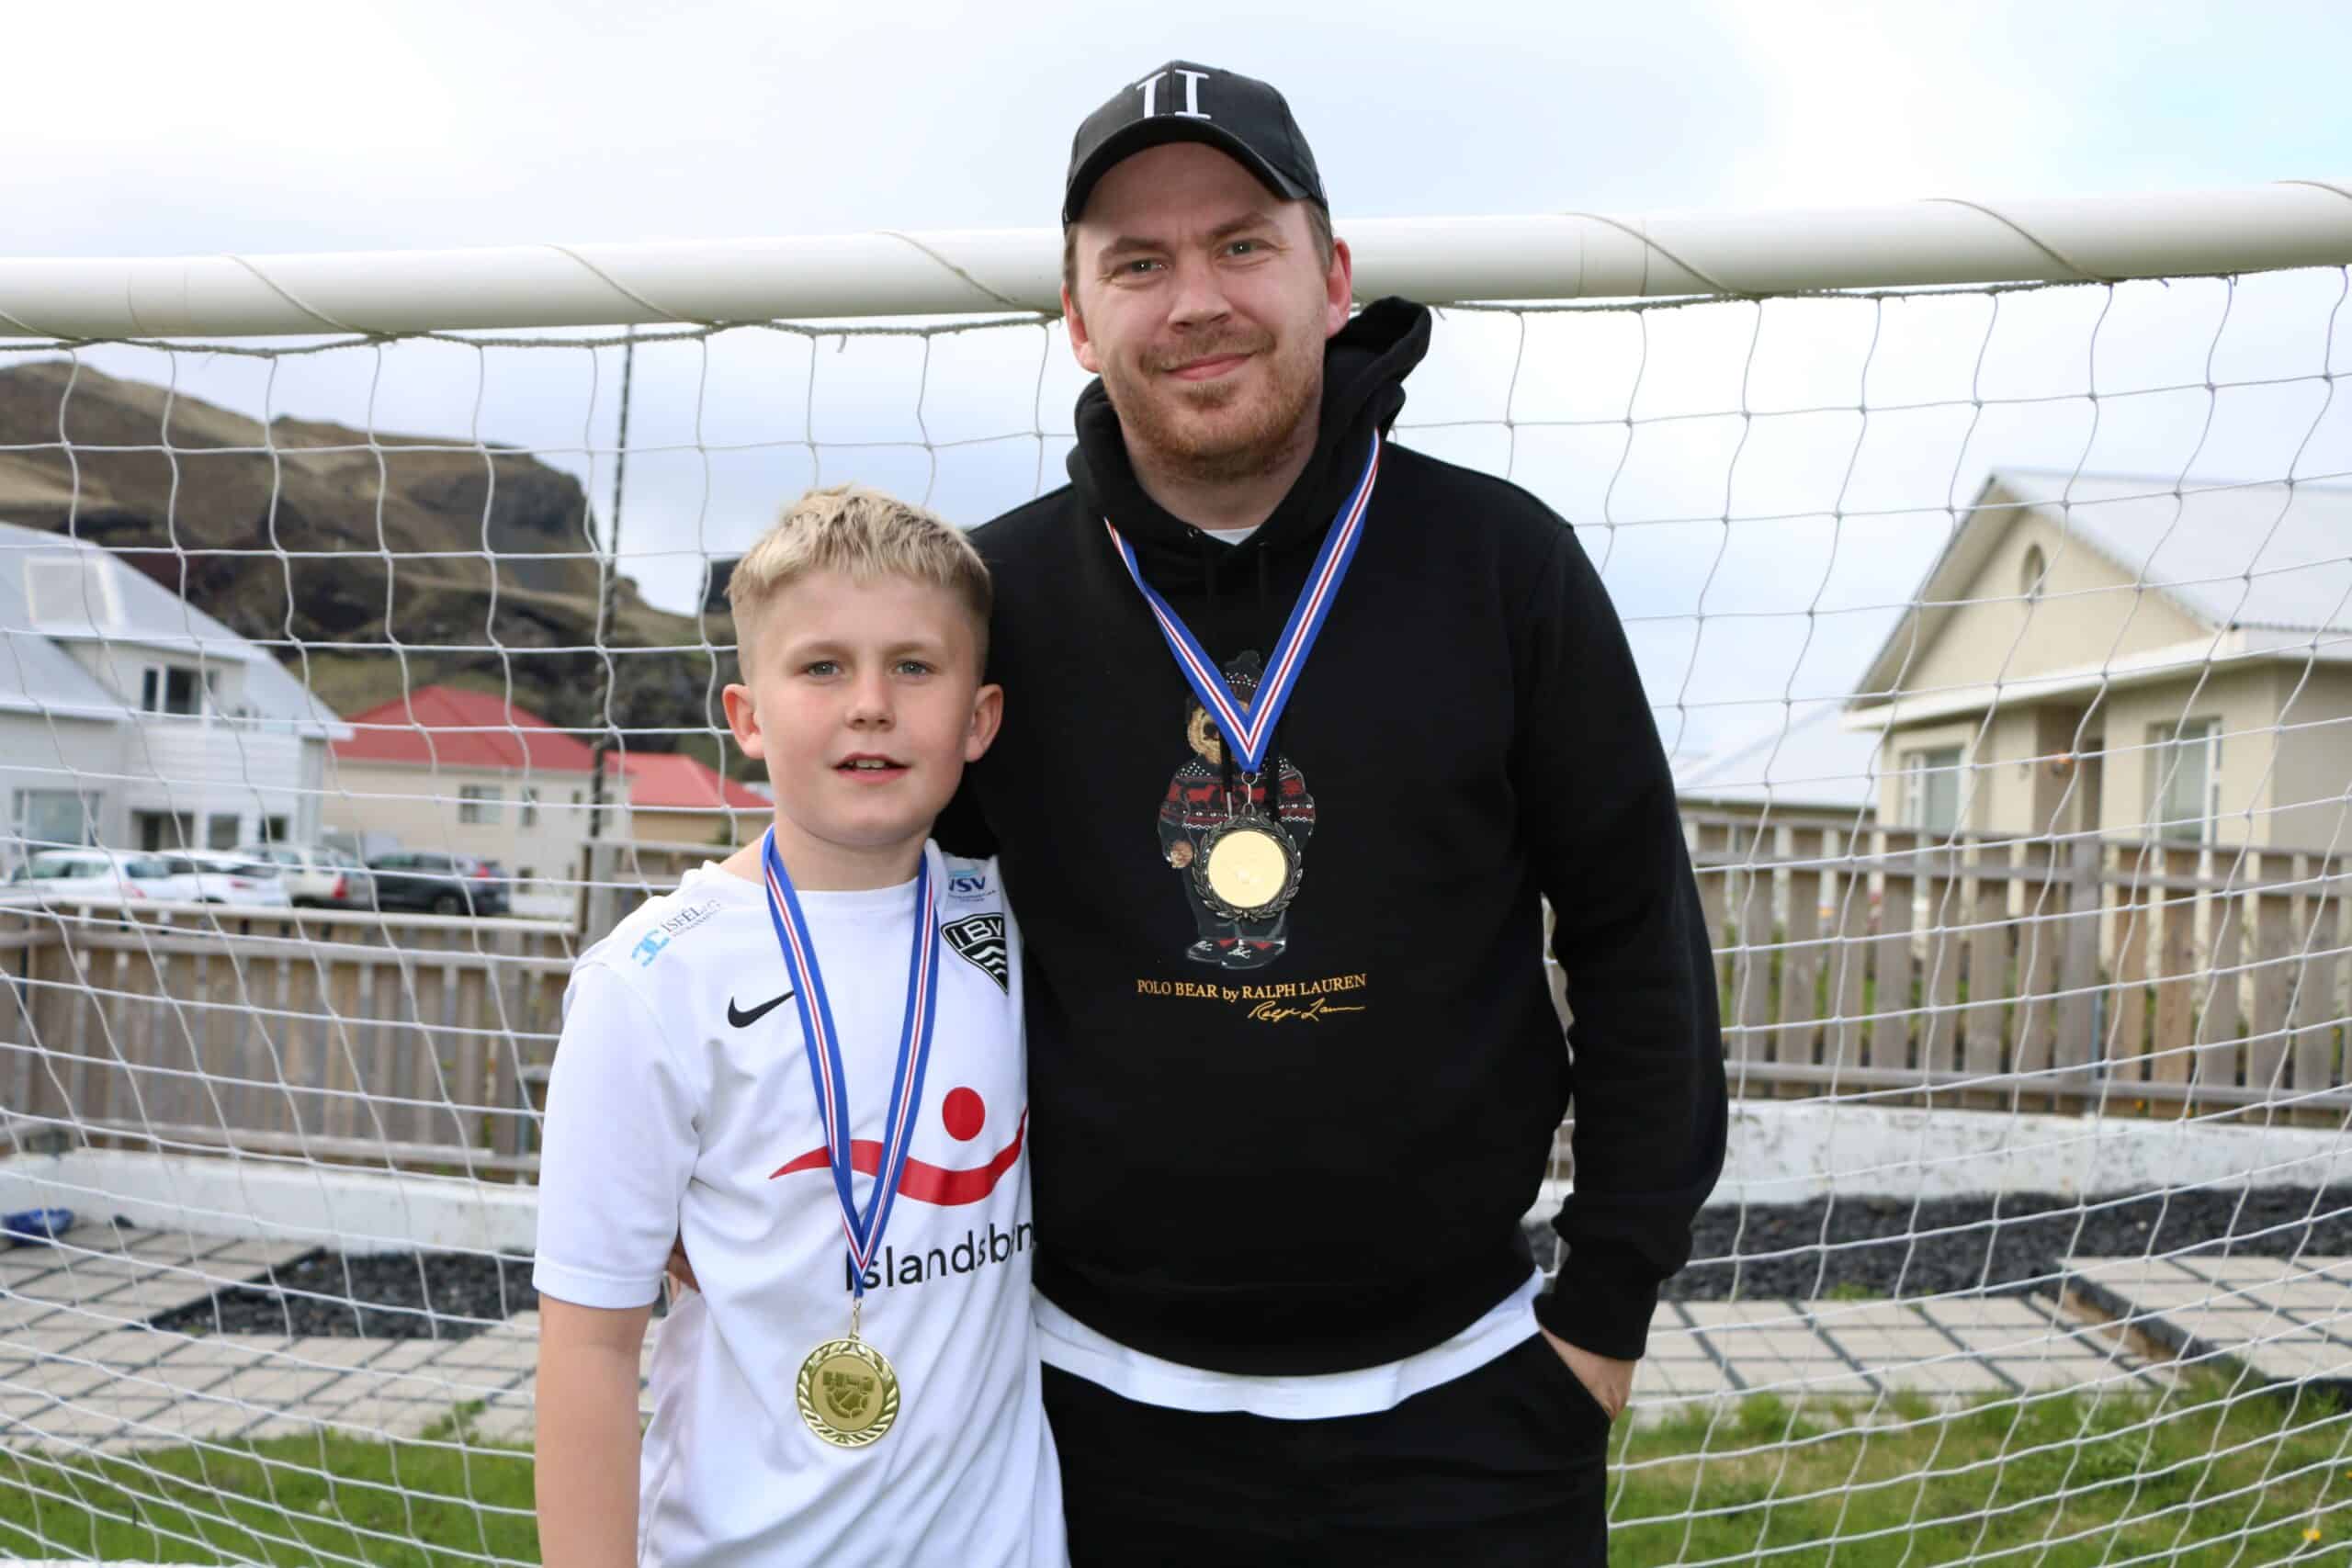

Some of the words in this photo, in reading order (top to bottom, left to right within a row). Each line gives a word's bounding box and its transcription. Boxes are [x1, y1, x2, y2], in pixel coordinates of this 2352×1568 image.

[1136, 979, 1171, 995] POLO
[1175, 982, 1218, 998] BEAR
[1222, 987, 1238, 1003] by
[1242, 983, 1296, 999] RALPH
[1300, 974, 1367, 996] LAUREN
